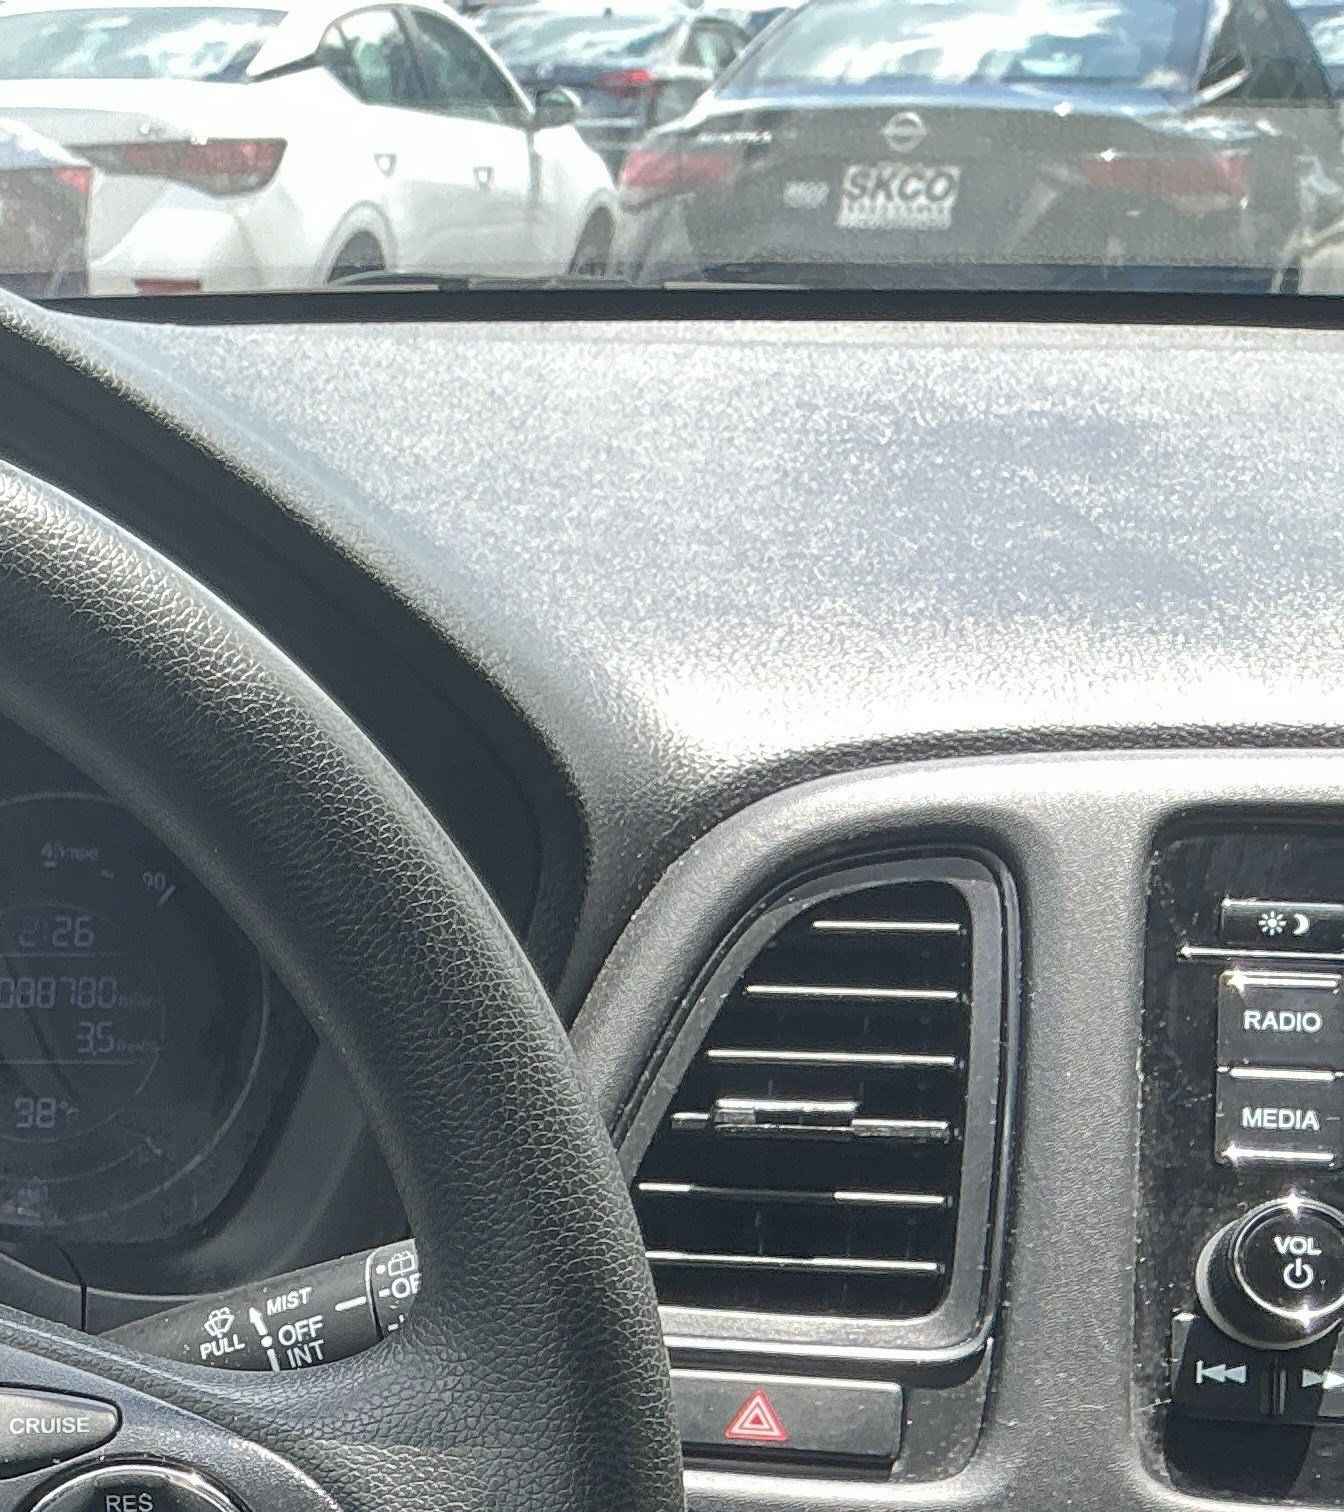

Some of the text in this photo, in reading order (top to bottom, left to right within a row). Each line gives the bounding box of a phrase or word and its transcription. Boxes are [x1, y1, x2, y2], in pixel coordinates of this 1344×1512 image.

[1242, 1010, 1322, 1034] RADIO
[1241, 1107, 1320, 1133] MEDIA
[1274, 1235, 1323, 1257] VOL
[267, 1286, 312, 1316] MIST
[278, 1314, 324, 1347] OFF
[200, 1333, 246, 1361] PULL
[286, 1339, 325, 1369] INT
[9, 1416, 92, 1435] CRUISE
